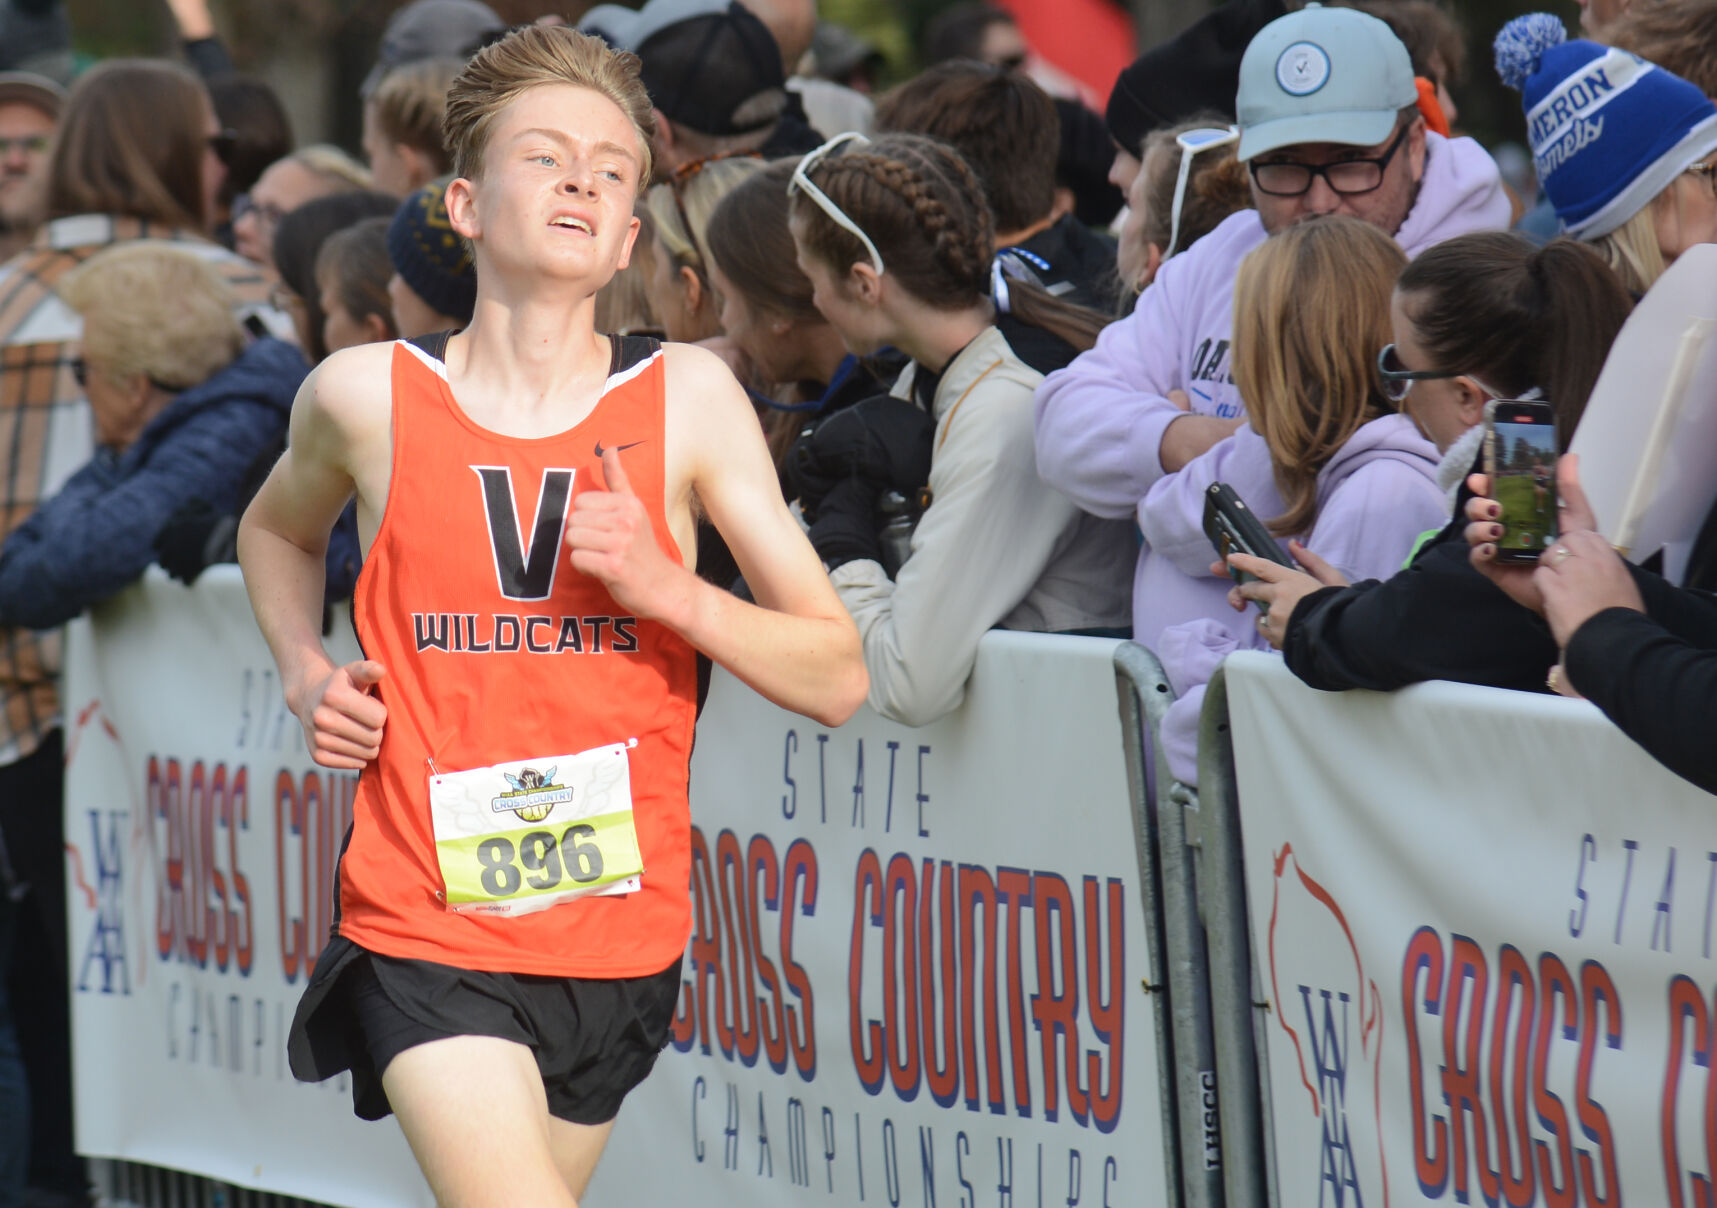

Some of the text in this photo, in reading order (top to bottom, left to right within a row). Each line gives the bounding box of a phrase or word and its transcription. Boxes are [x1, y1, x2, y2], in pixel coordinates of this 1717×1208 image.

[1531, 68, 1614, 146] MERON
[468, 465, 576, 602] V
[411, 612, 640, 654] WILDCATS
[494, 798, 527, 811] CROSS
[528, 789, 571, 805] COUNTRY
[782, 728, 931, 838] STATE
[147, 754, 254, 979] CROSS
[476, 824, 605, 897] 896
[1570, 832, 1717, 960] STAT
[848, 846, 1126, 1134] COUNTRY
[1402, 925, 1623, 1208] CROSS
